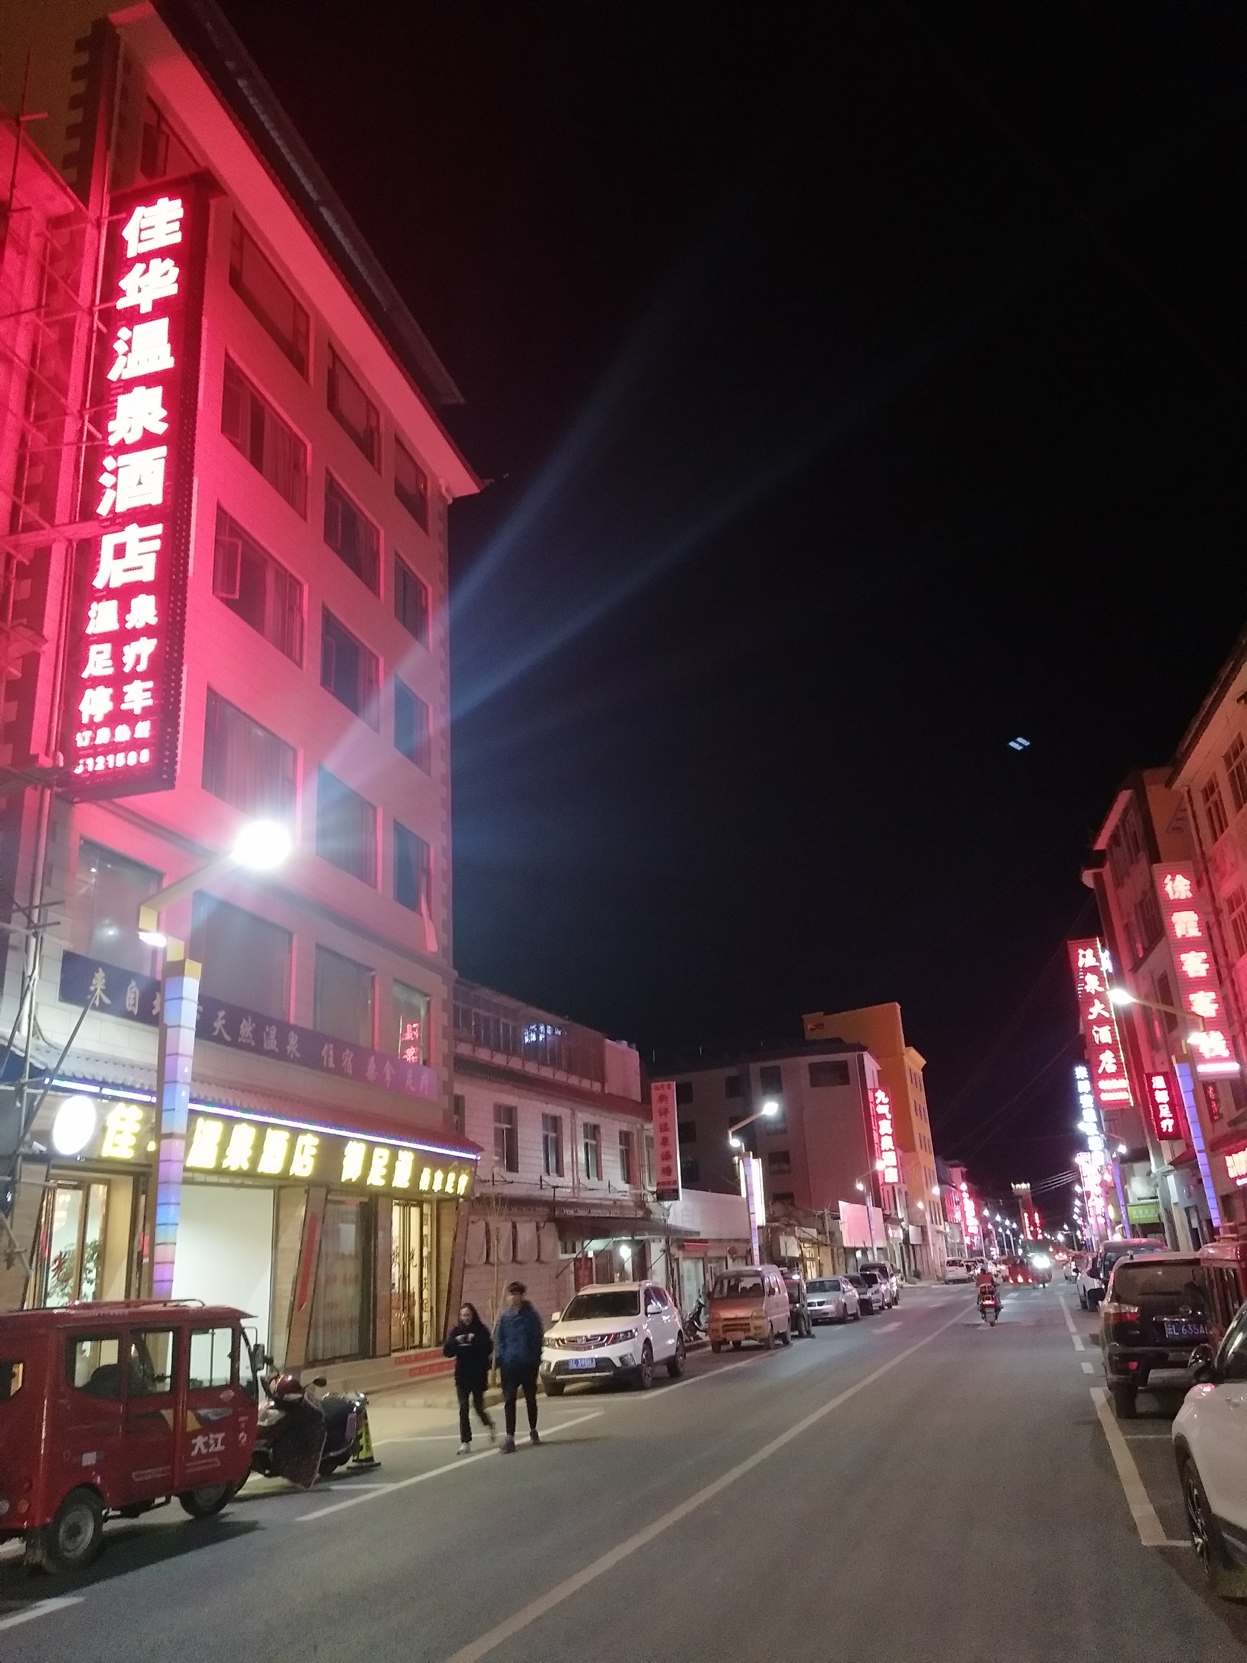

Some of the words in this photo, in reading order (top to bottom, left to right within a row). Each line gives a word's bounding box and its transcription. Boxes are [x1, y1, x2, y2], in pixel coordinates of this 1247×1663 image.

[92, 197, 184, 589] 佳华温泉酒店
[81, 637, 157, 678] 足疗
[79, 680, 153, 724] 停车
[1164, 874, 1230, 1059] 徐霞客客栈
[1077, 947, 1117, 1074] 温泉大酒店
[101, 1102, 321, 1178] 佳温泉酒店
[190, 1431, 226, 1457] 大江
